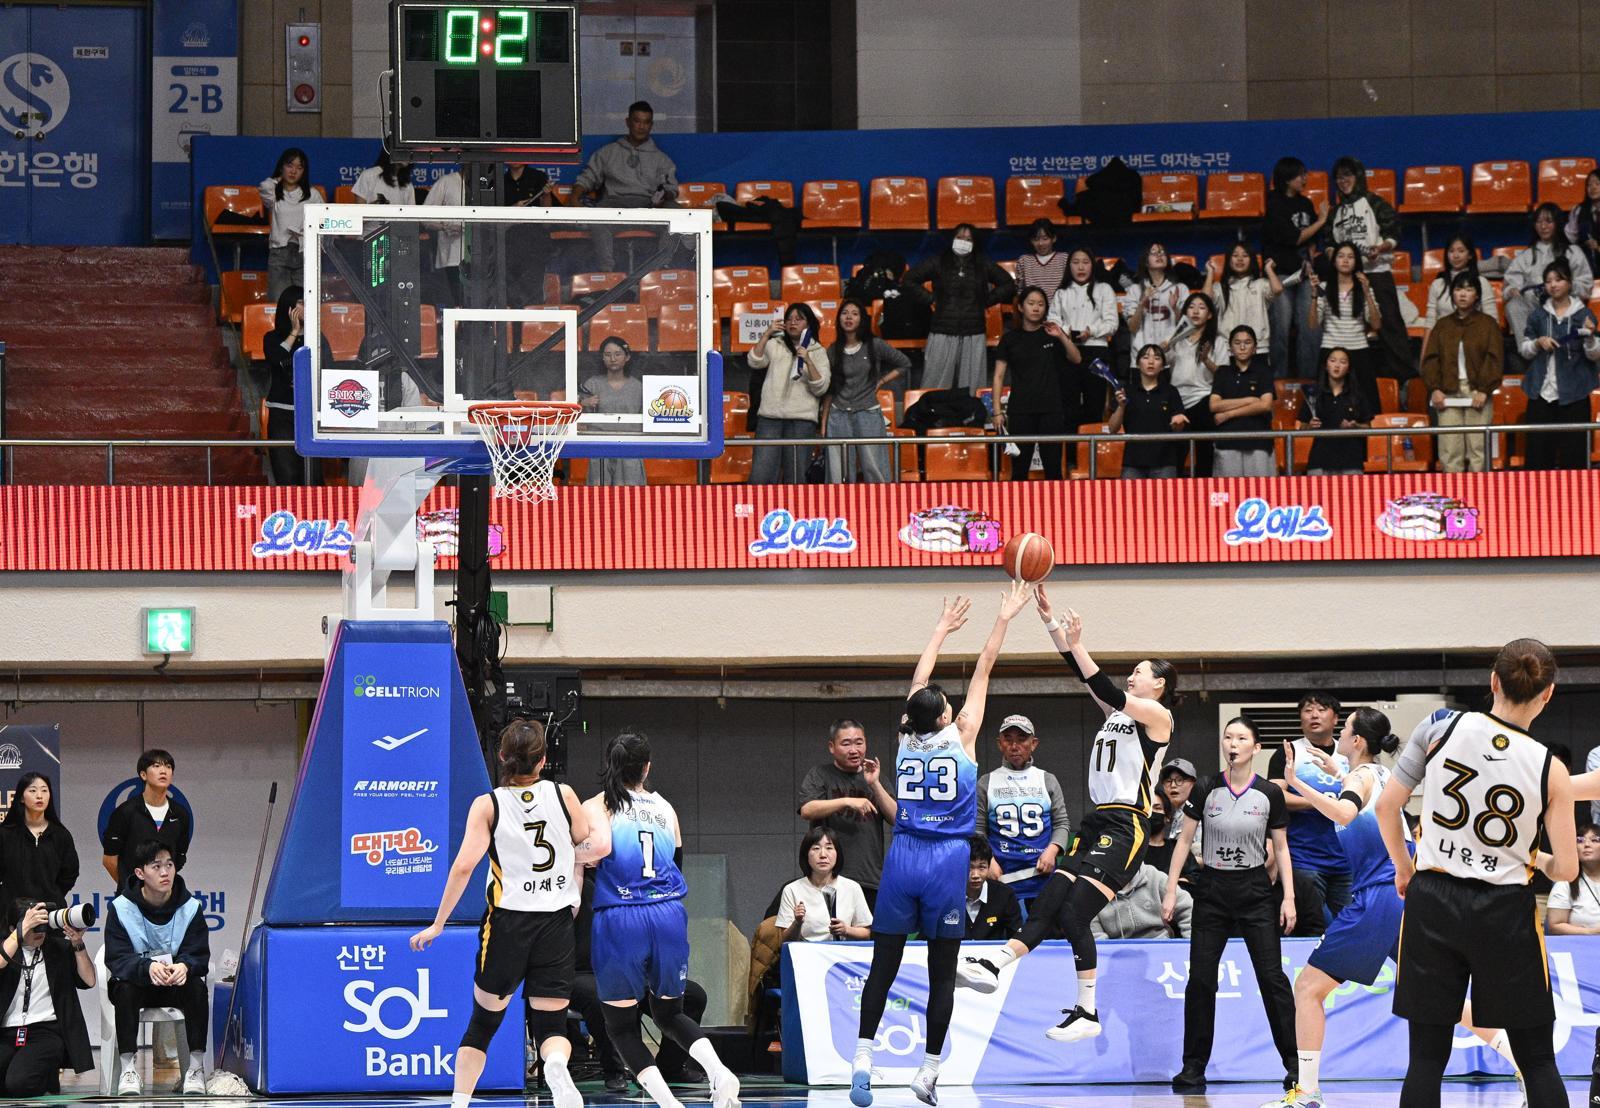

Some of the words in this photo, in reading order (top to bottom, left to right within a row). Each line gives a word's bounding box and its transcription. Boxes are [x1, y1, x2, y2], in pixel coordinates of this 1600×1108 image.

[168, 83, 224, 114] 2-B
[1008, 156, 1038, 171] 인천
[1041, 155, 1097, 172] 신한은행
[1160, 151, 1231, 168] 여자농구단
[330, 219, 353, 228] DAC
[328, 389, 354, 401] BNK
[253, 510, 353, 558] 오예스
[748, 508, 857, 557] 오예스
[1223, 497, 1333, 546] 오예스
[365, 686, 440, 698] CELLTRION
[1104, 722, 1135, 735] STARS
[1095, 738, 1118, 773] 11
[368, 781, 438, 791] ARMORFIT
[897, 757, 958, 801] 23
[1432, 758, 1525, 848] 38
[996, 803, 1045, 838] 99
[352, 828, 427, 865] 땡겨요
[524, 820, 556, 873] 3
[638, 831, 656, 879] 1
[1216, 846, 1250, 868] 한솔
[1438, 838, 1499, 872] 나윤정
[385, 866, 412, 875] 우리동네
[524, 875, 566, 894] 이채은
[336, 944, 387, 971] 신한
[365, 1044, 455, 1077] Bank
